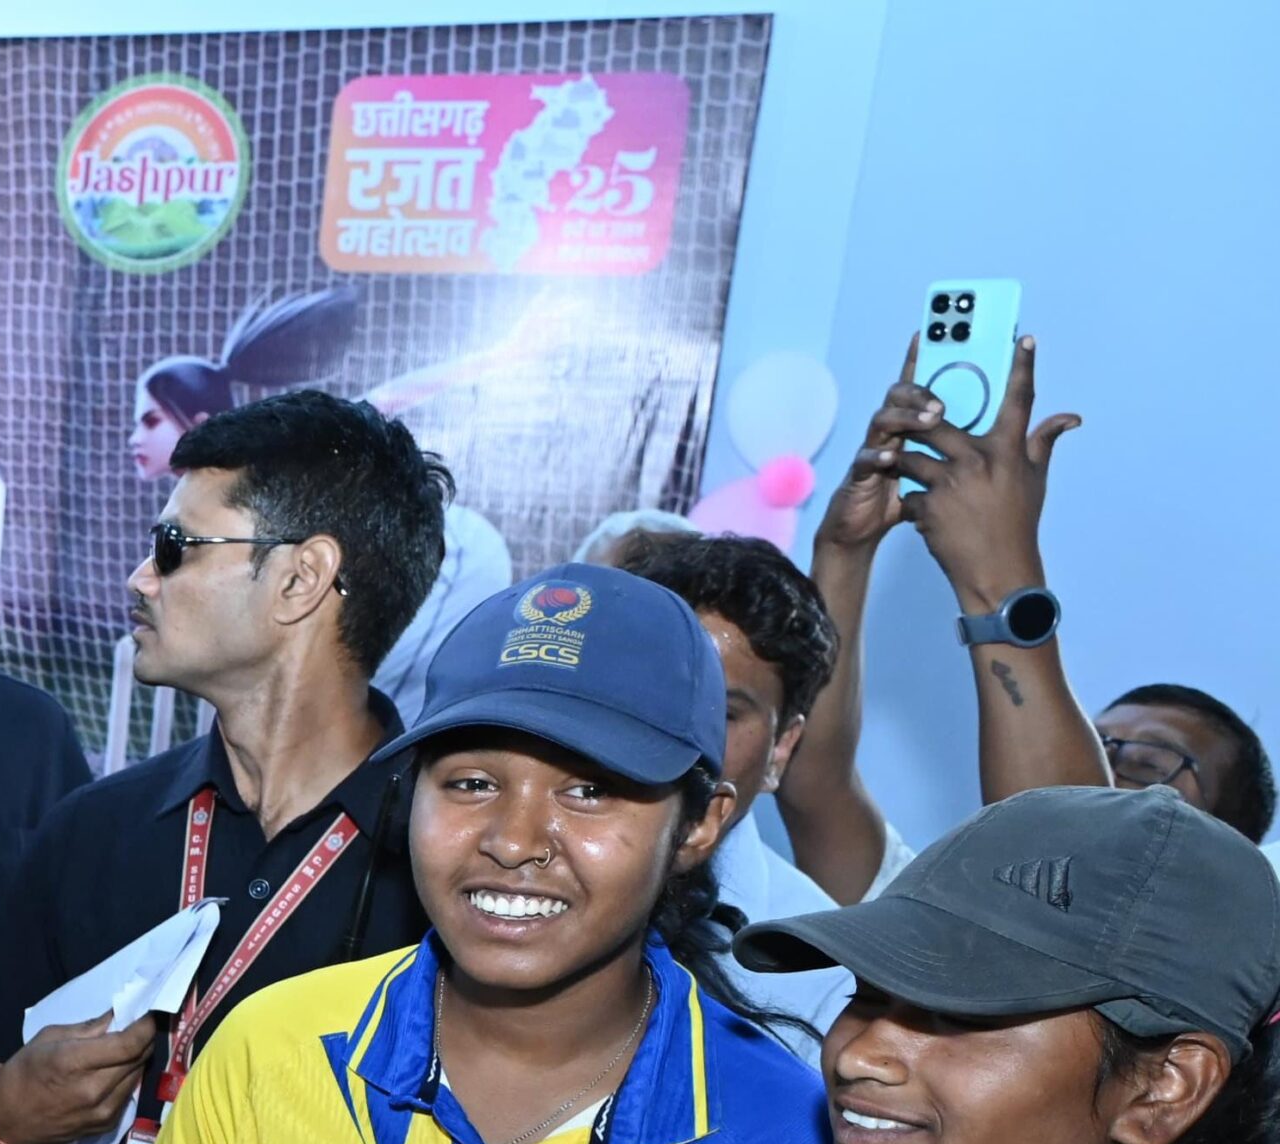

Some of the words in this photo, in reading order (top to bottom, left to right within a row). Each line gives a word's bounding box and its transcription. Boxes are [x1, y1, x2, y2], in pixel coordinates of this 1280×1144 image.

[70, 154, 236, 205] Jashpur
[345, 148, 484, 211] रजत
[569, 146, 657, 216] 25
[337, 206, 478, 256] महोत्सव
[500, 643, 580, 665] CSCS
